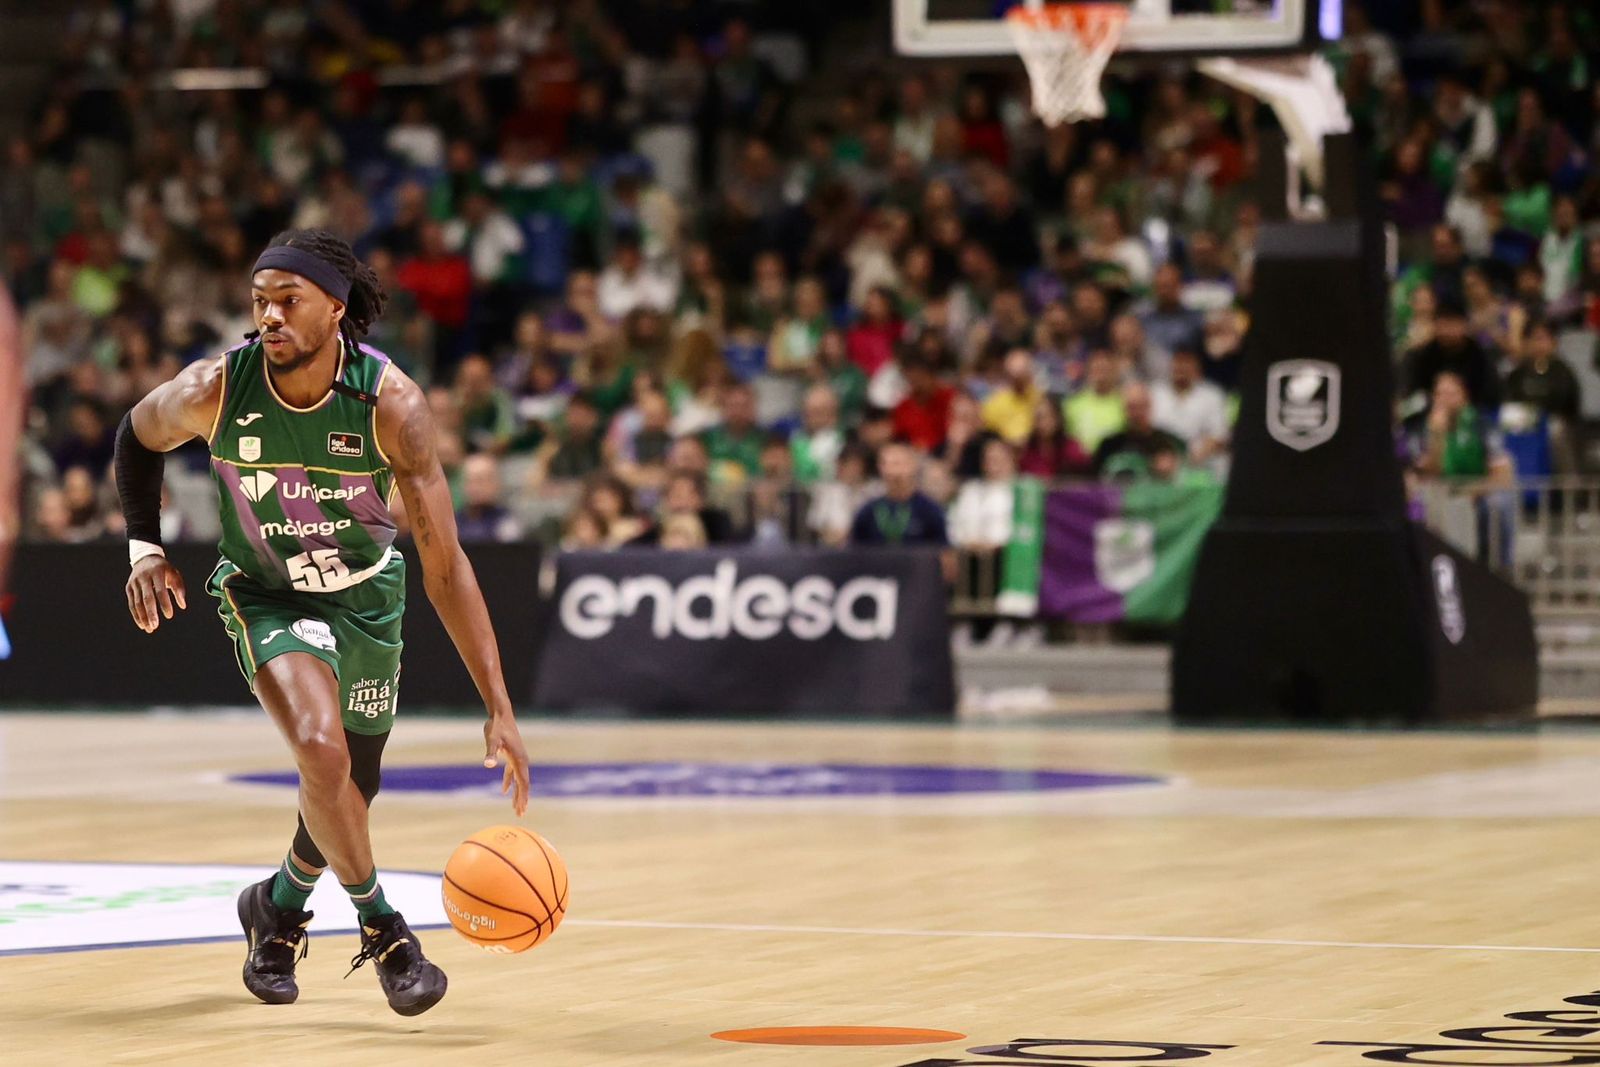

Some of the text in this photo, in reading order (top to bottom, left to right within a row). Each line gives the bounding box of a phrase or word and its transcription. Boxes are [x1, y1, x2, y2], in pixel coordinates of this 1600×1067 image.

[331, 438, 345, 447] liga
[331, 445, 360, 454] endesa
[282, 481, 367, 503] Unicaja
[285, 548, 350, 592] 55
[559, 558, 899, 640] endesa
[351, 677, 380, 690] sabor
